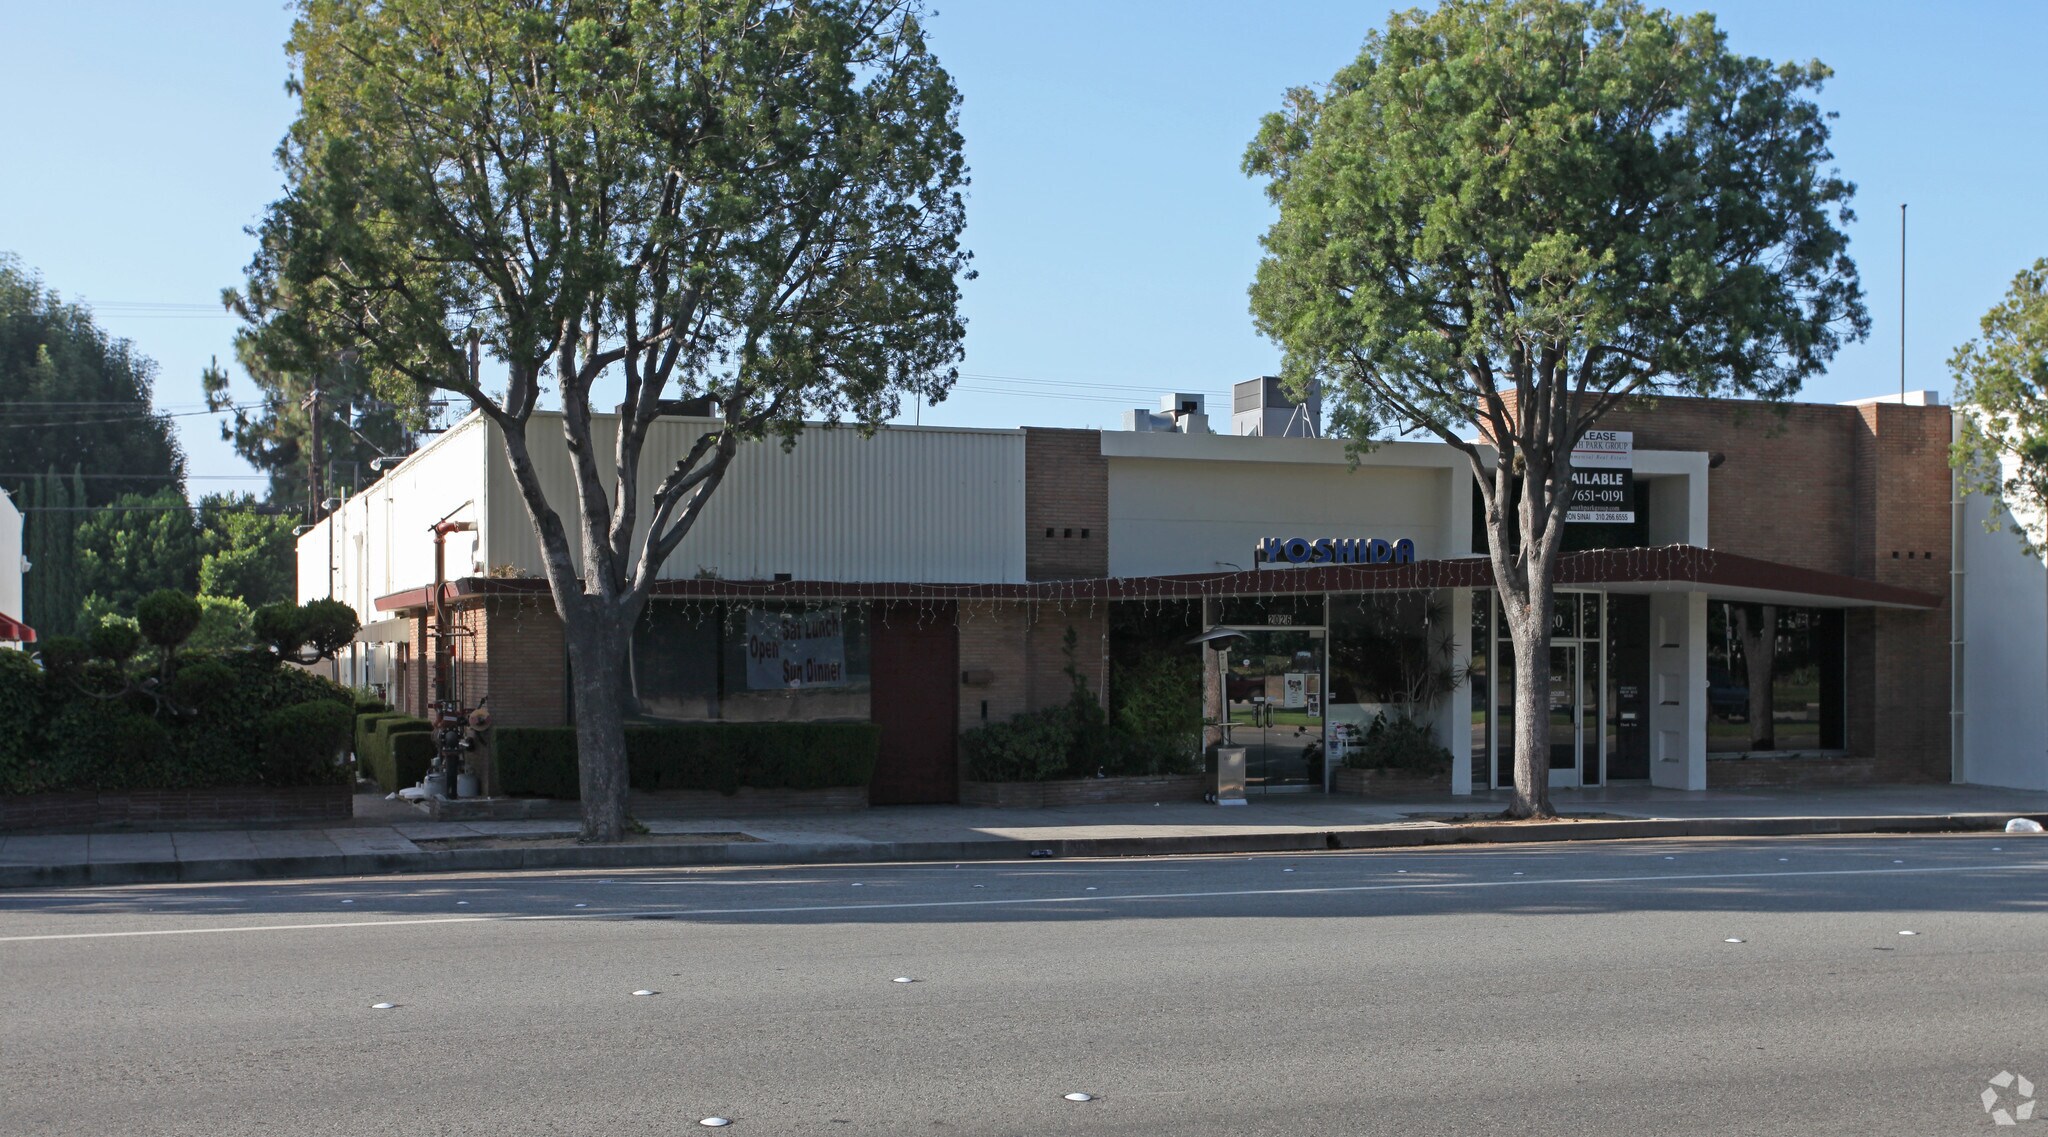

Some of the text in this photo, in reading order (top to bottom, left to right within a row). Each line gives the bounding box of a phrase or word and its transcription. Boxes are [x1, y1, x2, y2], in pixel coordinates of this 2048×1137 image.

[1583, 431, 1616, 441] LEASE
[1586, 441, 1603, 450] PARK
[1605, 442, 1628, 450] GROUP
[1571, 472, 1623, 485] AILABLE
[1596, 513, 1628, 521] 310.266.6555
[1261, 537, 1415, 563] YOSHIDA
[805, 613, 839, 639] Lunch
[1268, 615, 1292, 625] 2026
[750, 634, 779, 664] Open
[783, 657, 842, 683] Sun Dinner
